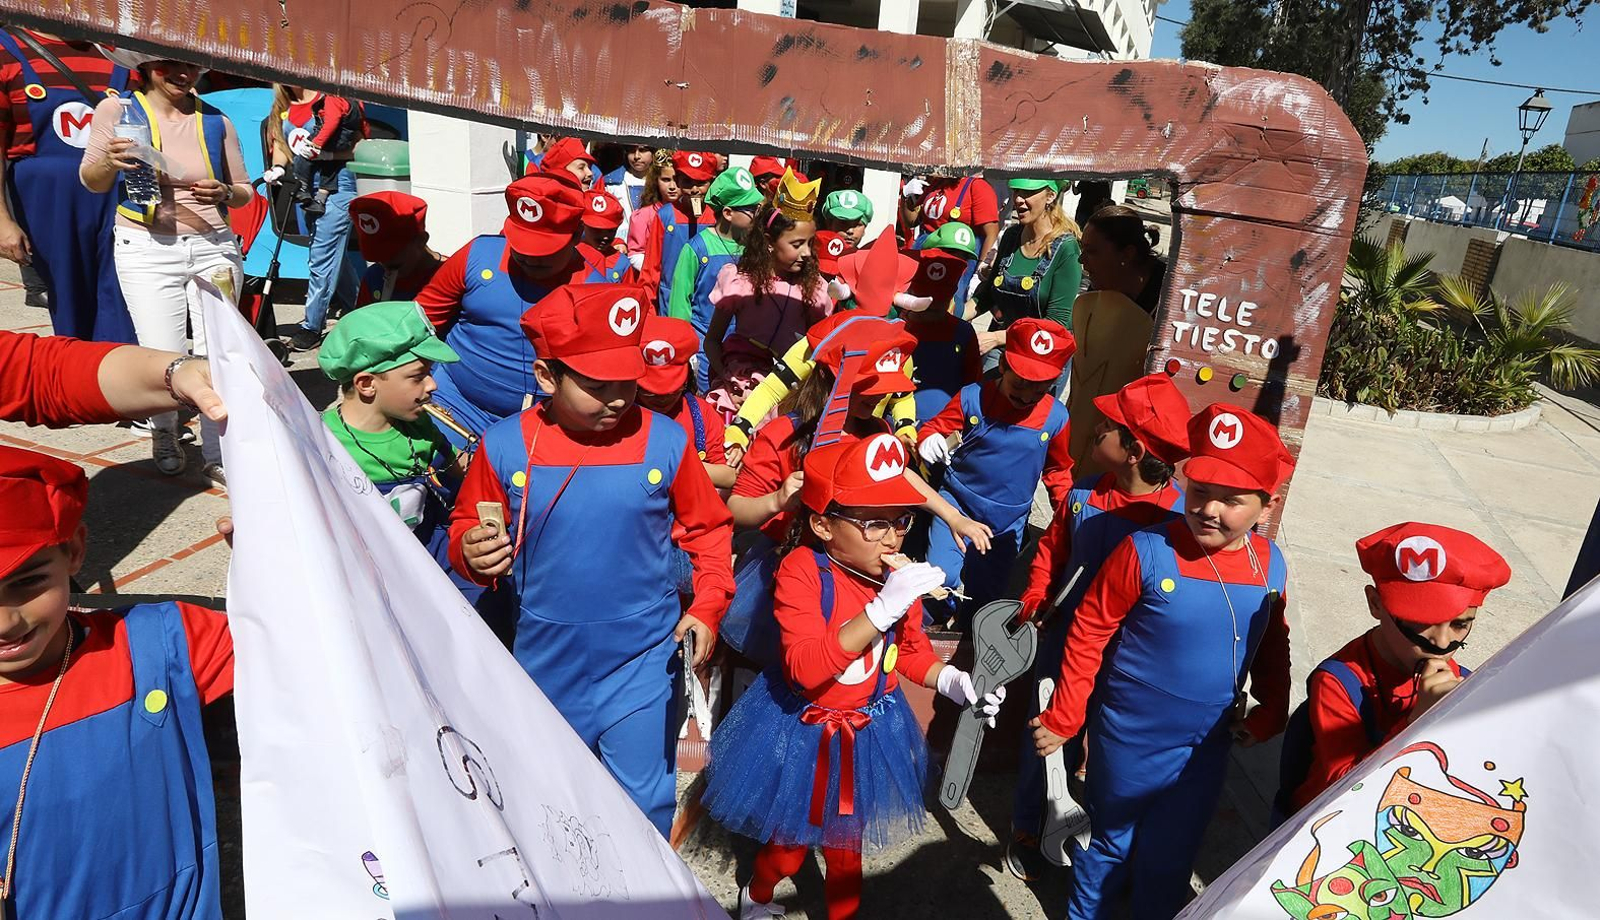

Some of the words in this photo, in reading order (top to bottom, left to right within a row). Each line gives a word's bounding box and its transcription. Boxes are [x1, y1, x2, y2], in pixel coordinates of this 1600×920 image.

[61, 111, 93, 137] M
[594, 199, 604, 207] M
[844, 193, 853, 206] L
[520, 201, 538, 217] M
[360, 217, 378, 228] M
[830, 242, 841, 252] M
[930, 266, 943, 277] M
[1179, 288, 1258, 327] TELE
[614, 306, 637, 328] M
[1034, 334, 1050, 350] M
[1171, 321, 1280, 360] TIESTO
[646, 348, 670, 365] M
[1213, 419, 1237, 442] M
[871, 442, 904, 470] M
[1400, 547, 1438, 577] M
